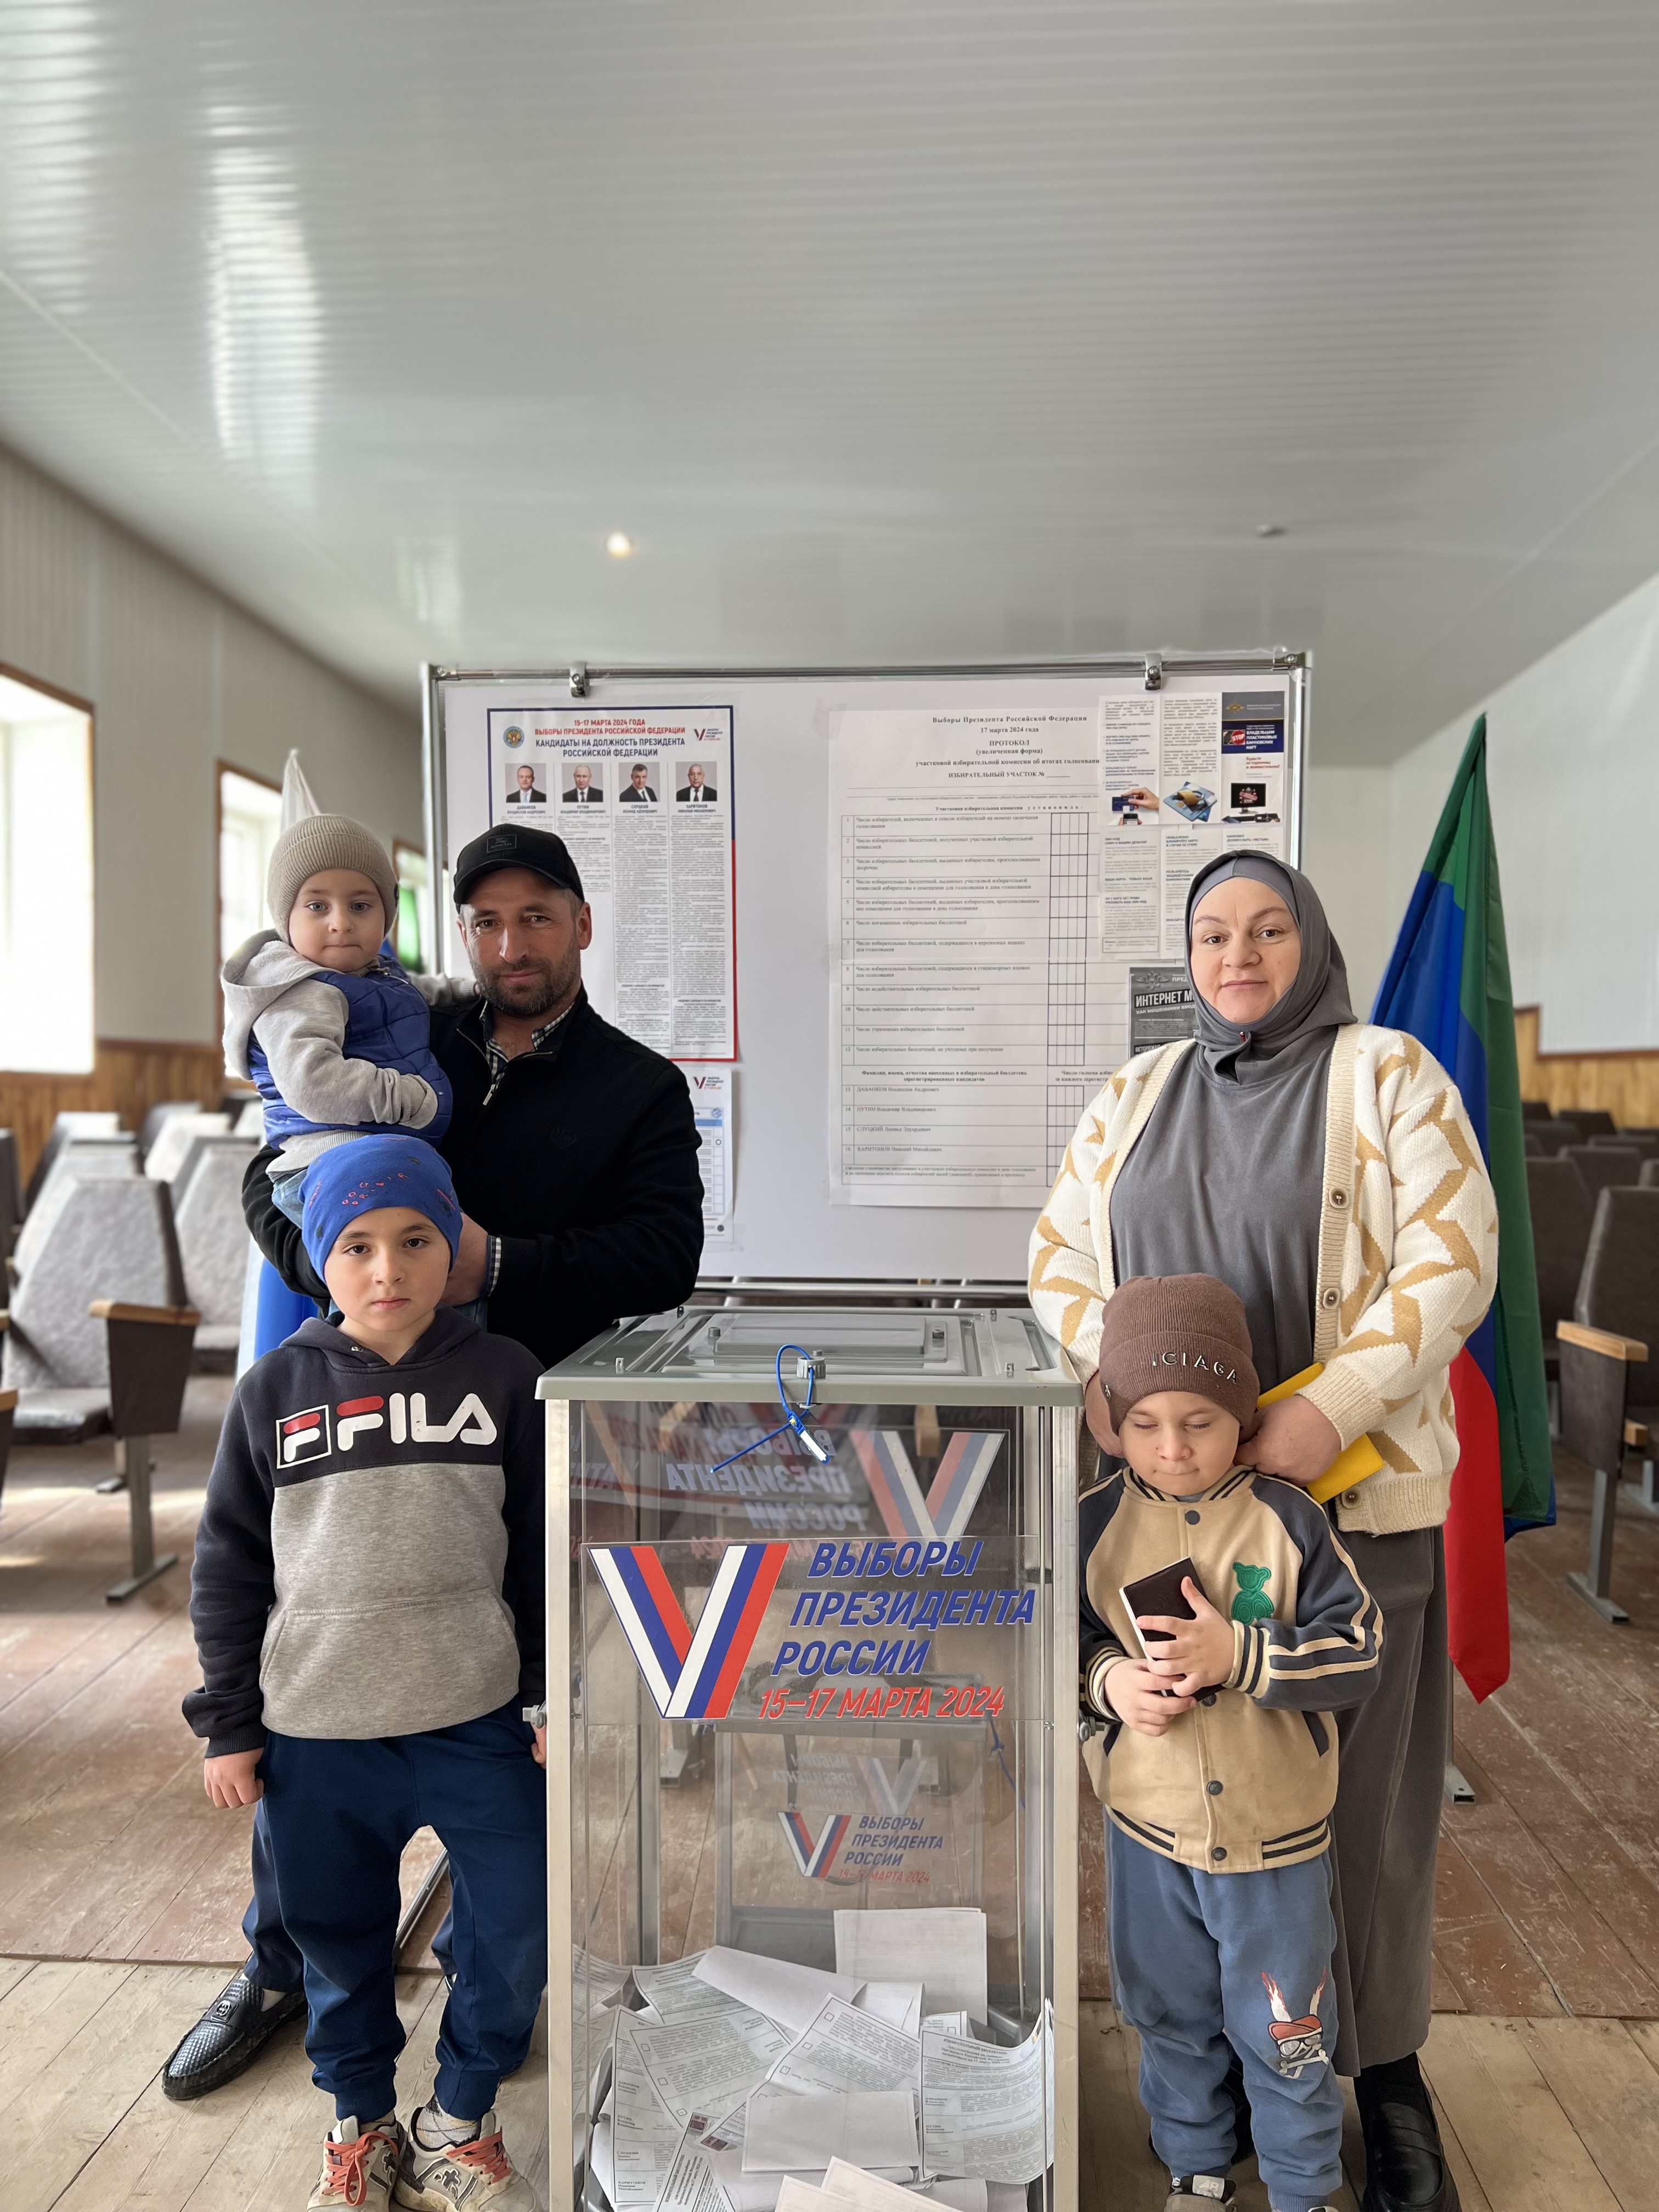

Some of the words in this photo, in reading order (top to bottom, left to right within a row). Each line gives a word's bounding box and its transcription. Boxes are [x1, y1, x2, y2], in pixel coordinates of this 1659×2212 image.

[604, 726, 646, 734] РОССИЙСКОЙ
[647, 726, 685, 735] ФЕДЕРАЦИИ
[629, 719, 645, 727] ГОДА
[535, 739, 579, 748] КАНДИДАТЫ
[582, 738, 591, 748] НА
[592, 738, 637, 747] ДОЛЖНОСТЬ
[639, 738, 685, 747] ПРЕЗИДЕНТА
[563, 747, 611, 757] РОССИЙСКОЙ
[613, 748, 658, 757] ФЕДЕРАЦИИ
[1136, 990, 1182, 1007] ИНТЕРНЕТ
[336, 1392, 498, 1452] FILA
[806, 1541, 984, 1578] ВЫБОРЫ
[789, 1588, 1036, 1631] ПРЕЗИДЕНТА
[770, 1639, 932, 1677] РОССИИ
[837, 1687, 932, 1719] МАРТА
[936, 1685, 1005, 1718] 2024
[859, 1816, 925, 1831] ВЫБОРЫ
[851, 1834, 944, 1850] ПРЕЗИДЕНТА
[844, 1851, 904, 1866] РОССИИ
[870, 1870, 904, 1883] МАРТА
[905, 1871, 930, 1884] 2024
